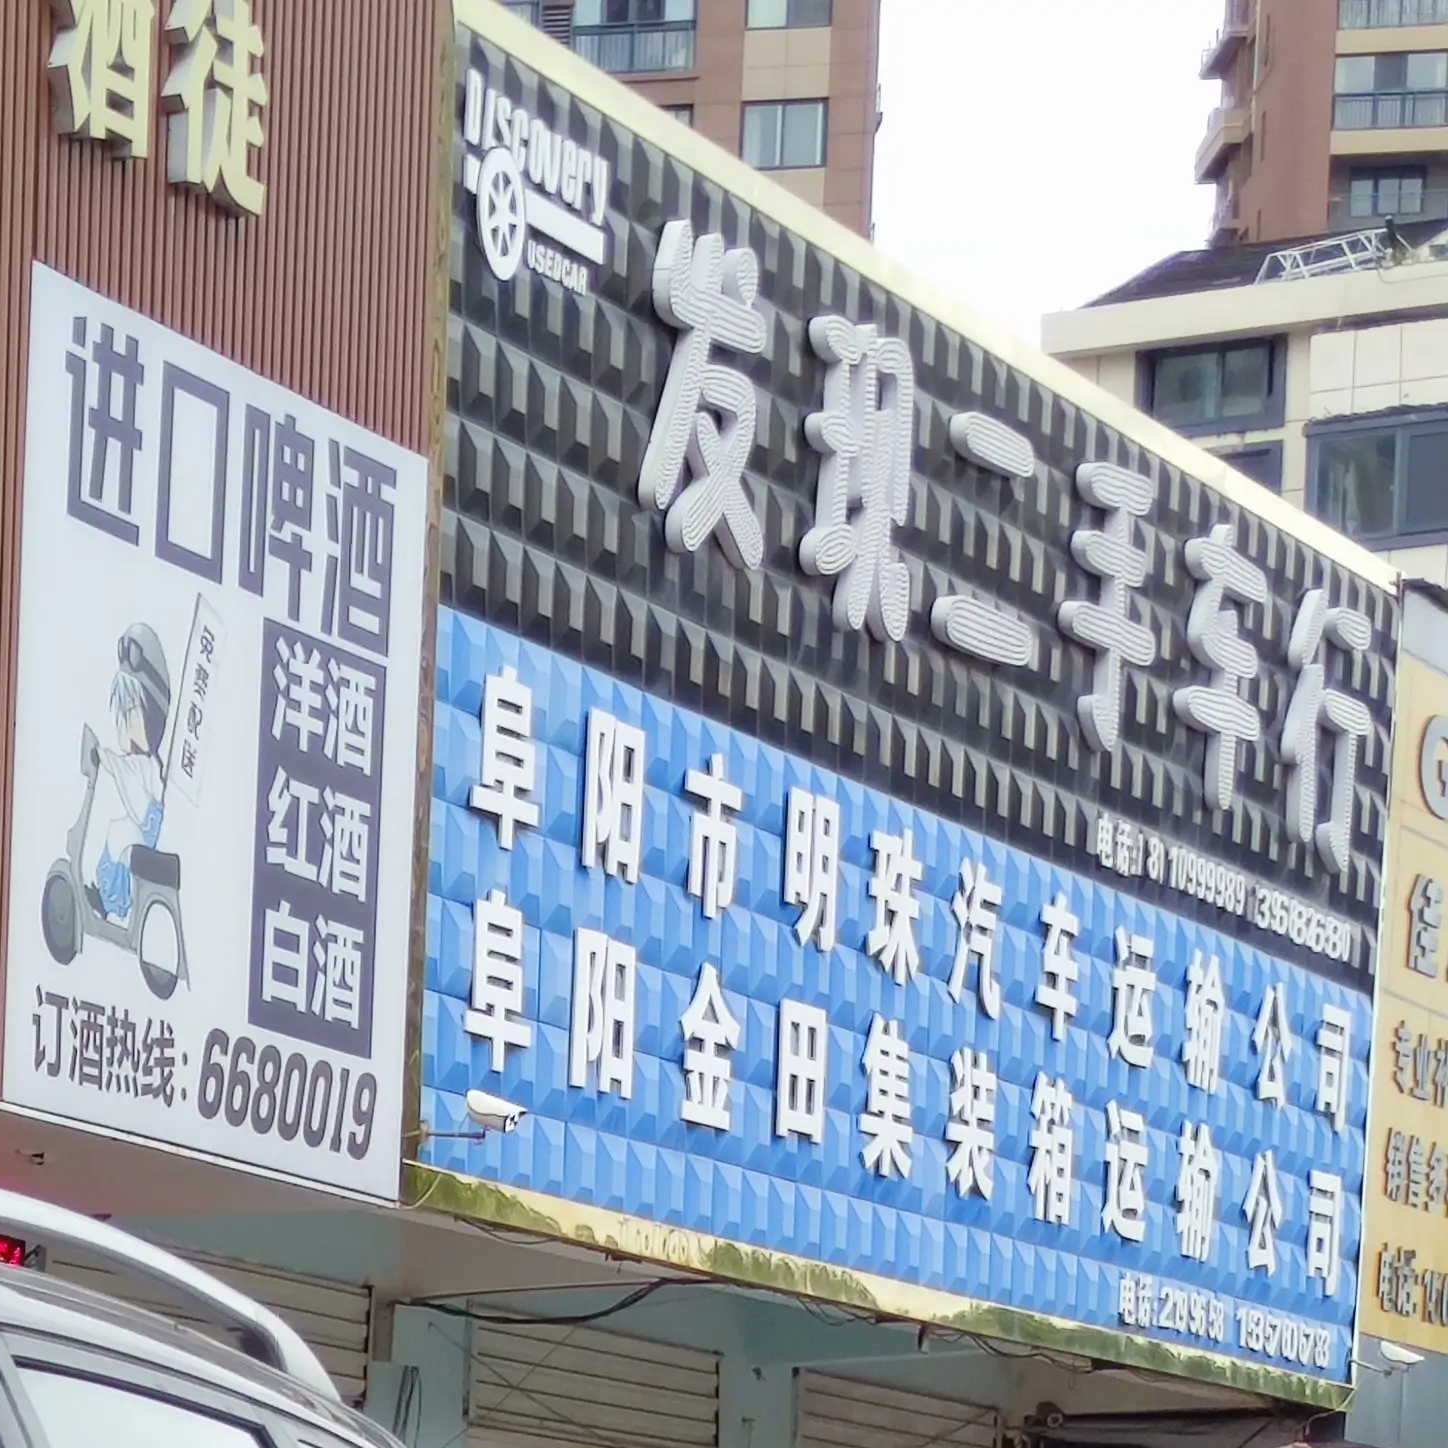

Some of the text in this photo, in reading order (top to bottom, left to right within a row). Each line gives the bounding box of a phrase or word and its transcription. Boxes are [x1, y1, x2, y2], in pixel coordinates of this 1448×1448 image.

[64, 315, 397, 657] 进口啤酒
[640, 218, 1373, 876] 发现二手车行
[265, 765, 372, 904] 红酒
[269, 634, 376, 778] 洋酒
[261, 899, 365, 1031] 白酒
[468, 664, 1355, 1143] 阜阳市明珠汽车运输公司
[463, 888, 1344, 1299] 阜阳金田集装箱运输公司
